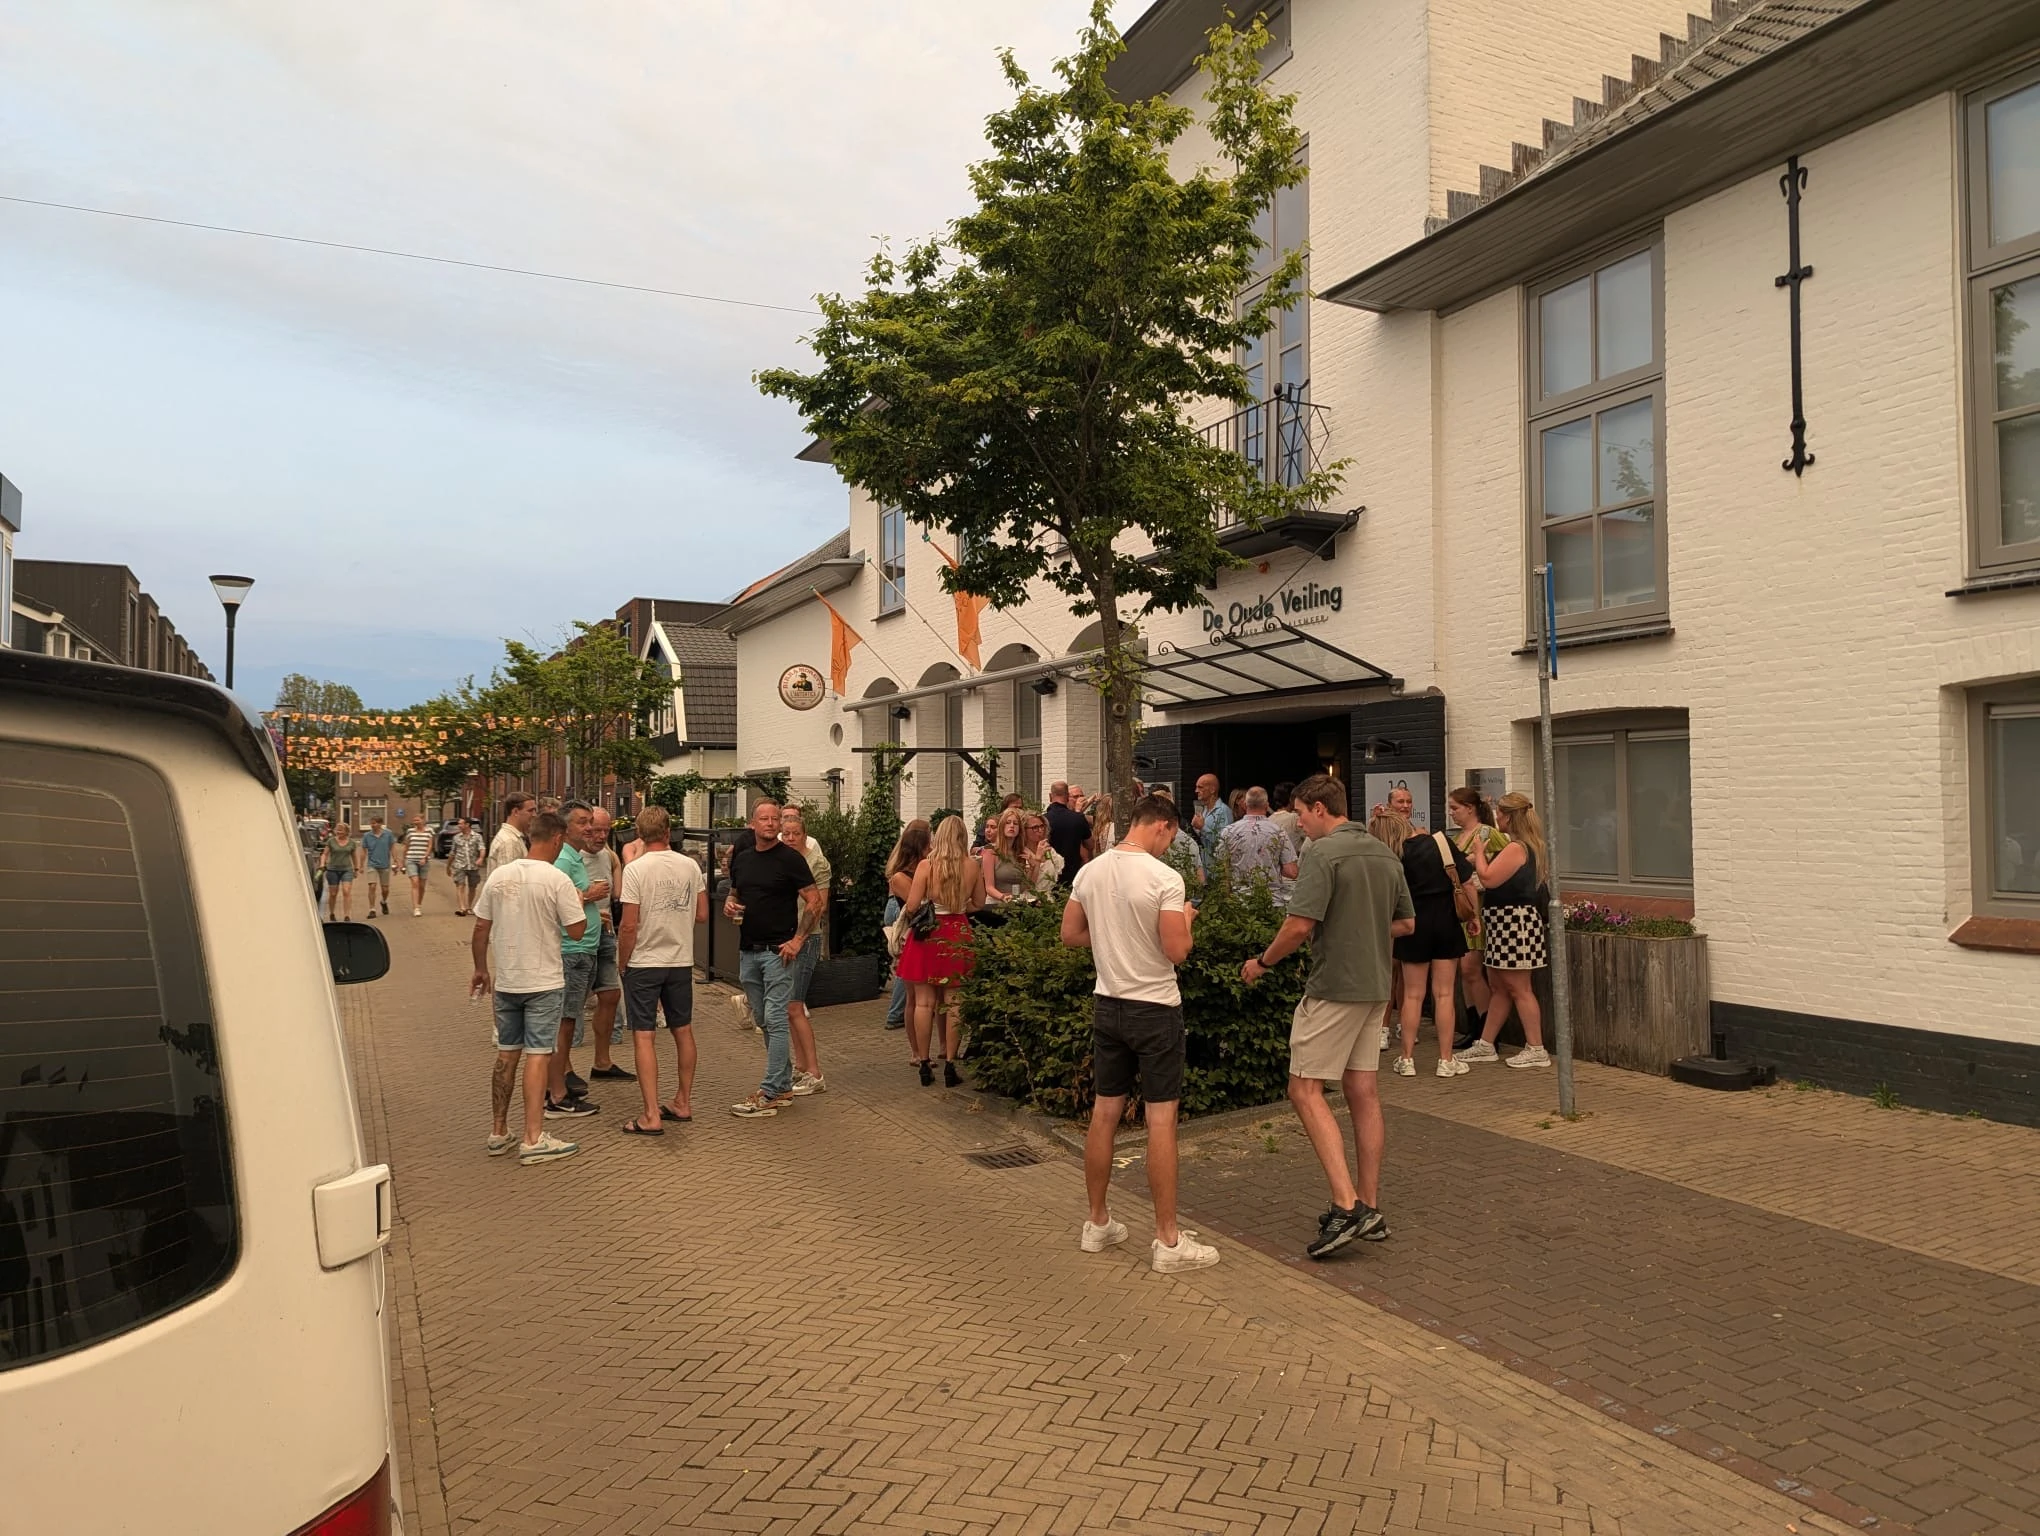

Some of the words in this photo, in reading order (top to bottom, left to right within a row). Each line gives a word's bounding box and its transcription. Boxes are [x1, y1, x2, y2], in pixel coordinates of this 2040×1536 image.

[1203, 610, 1223, 632] De
[1229, 594, 1274, 625] Oude
[1280, 582, 1342, 614] Veiling
